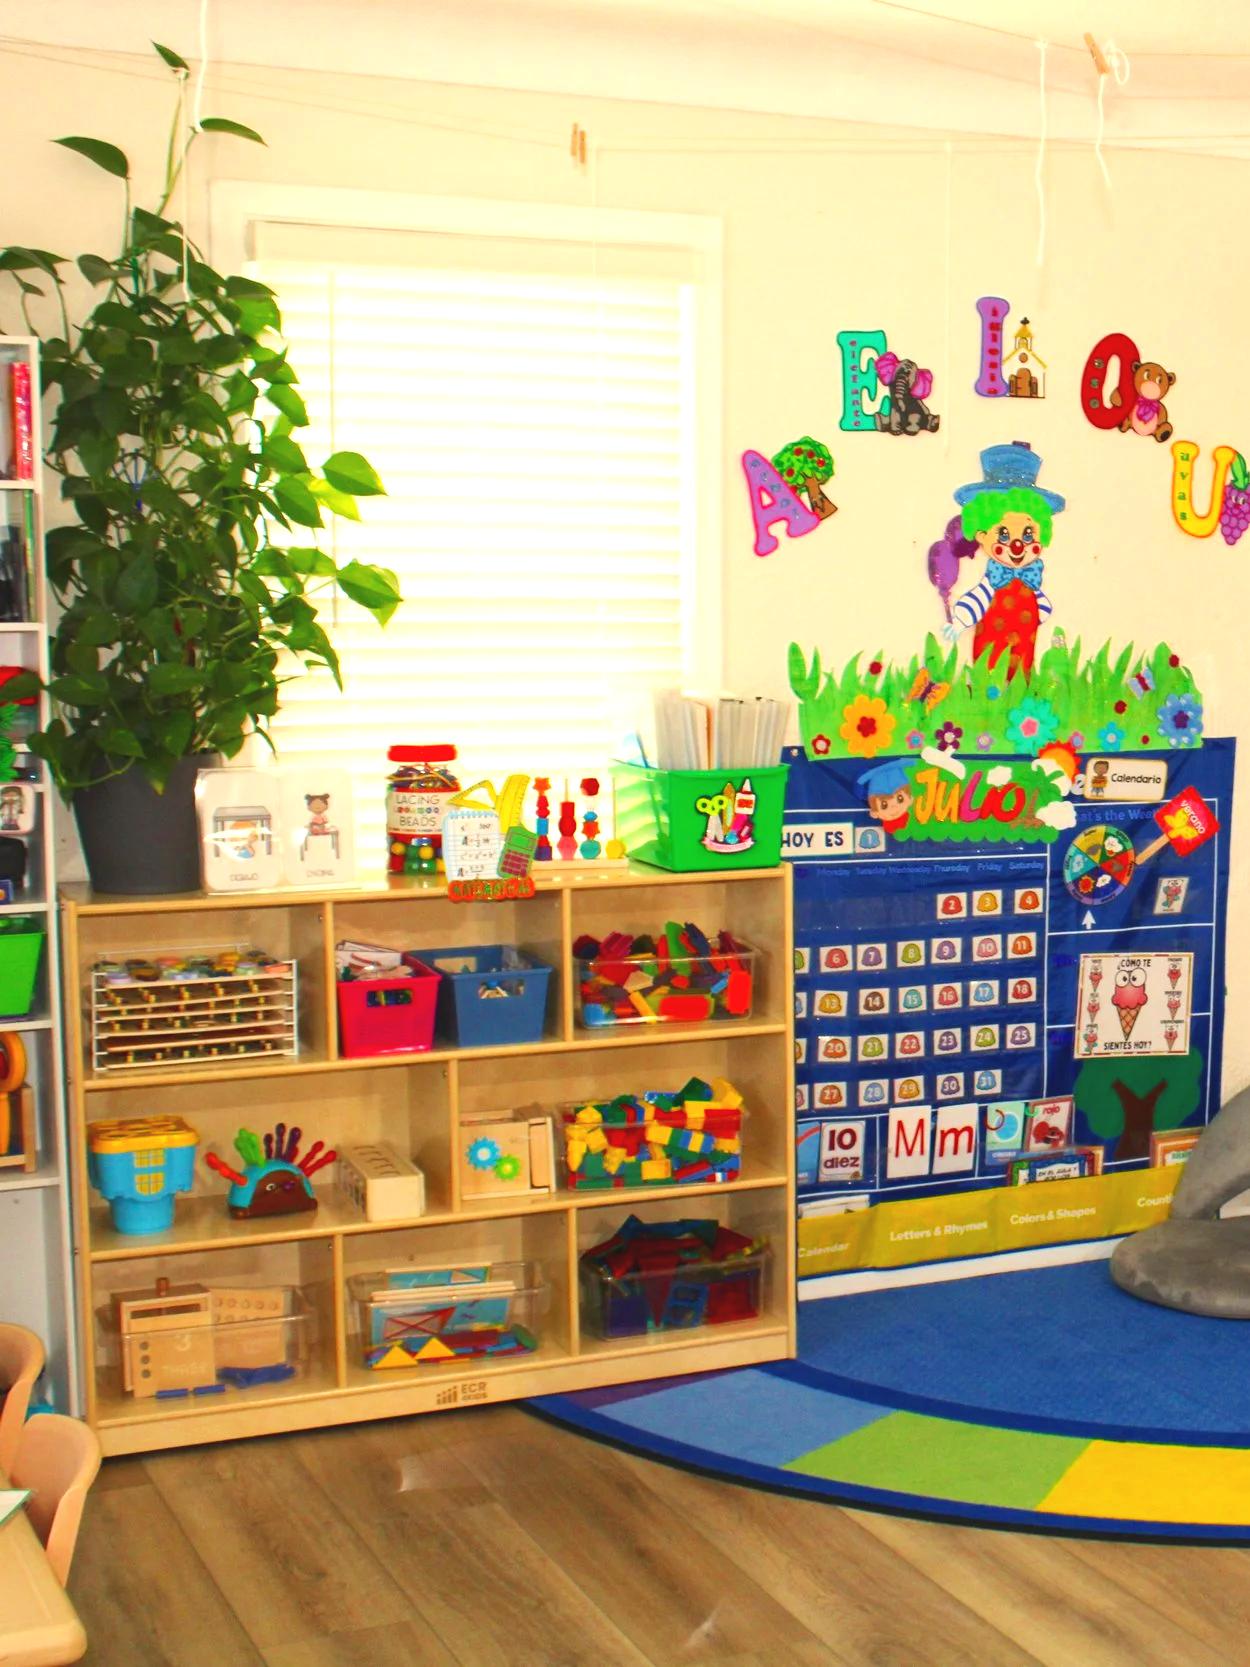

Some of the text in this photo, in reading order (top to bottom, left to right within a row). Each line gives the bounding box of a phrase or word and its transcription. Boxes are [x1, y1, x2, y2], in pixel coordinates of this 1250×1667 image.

[975, 297, 1009, 397] I
[837, 330, 890, 431] E
[1080, 332, 1141, 430] O
[1171, 440, 1236, 539] U
[1177, 452, 1190, 521] uvas
[742, 449, 820, 557] A
[1111, 773, 1162, 785] Calendario
[396, 795, 440, 805] LACING
[400, 816, 437, 827] BEADS
[1181, 800, 1206, 835] verano
[782, 831, 874, 848] HOY ES 1
[948, 895, 1032, 910] 2 3 4
[833, 941, 1027, 963] 6 7 8 9 10 11
[1143, 959, 1151, 967] TE
[824, 985, 1027, 1009] 13 14 15 16 17 18
[828, 1031, 1027, 1052] 20 21 22 23 24 25
[1104, 1041, 1152, 1050] SIENTES HOY?
[825, 1076, 993, 1099] 27 28 29 30 31
[1042, 1105, 1061, 1116] rojo
[828, 1128, 857, 1151] 10
[895, 1118, 974, 1158] M m
[823, 1156, 860, 1170] diez
[1010, 1205, 1096, 1225] Colors & Shapes
[890, 1220, 988, 1242] Letters & Rhymes
[461, 1381, 487, 1394] ECR
